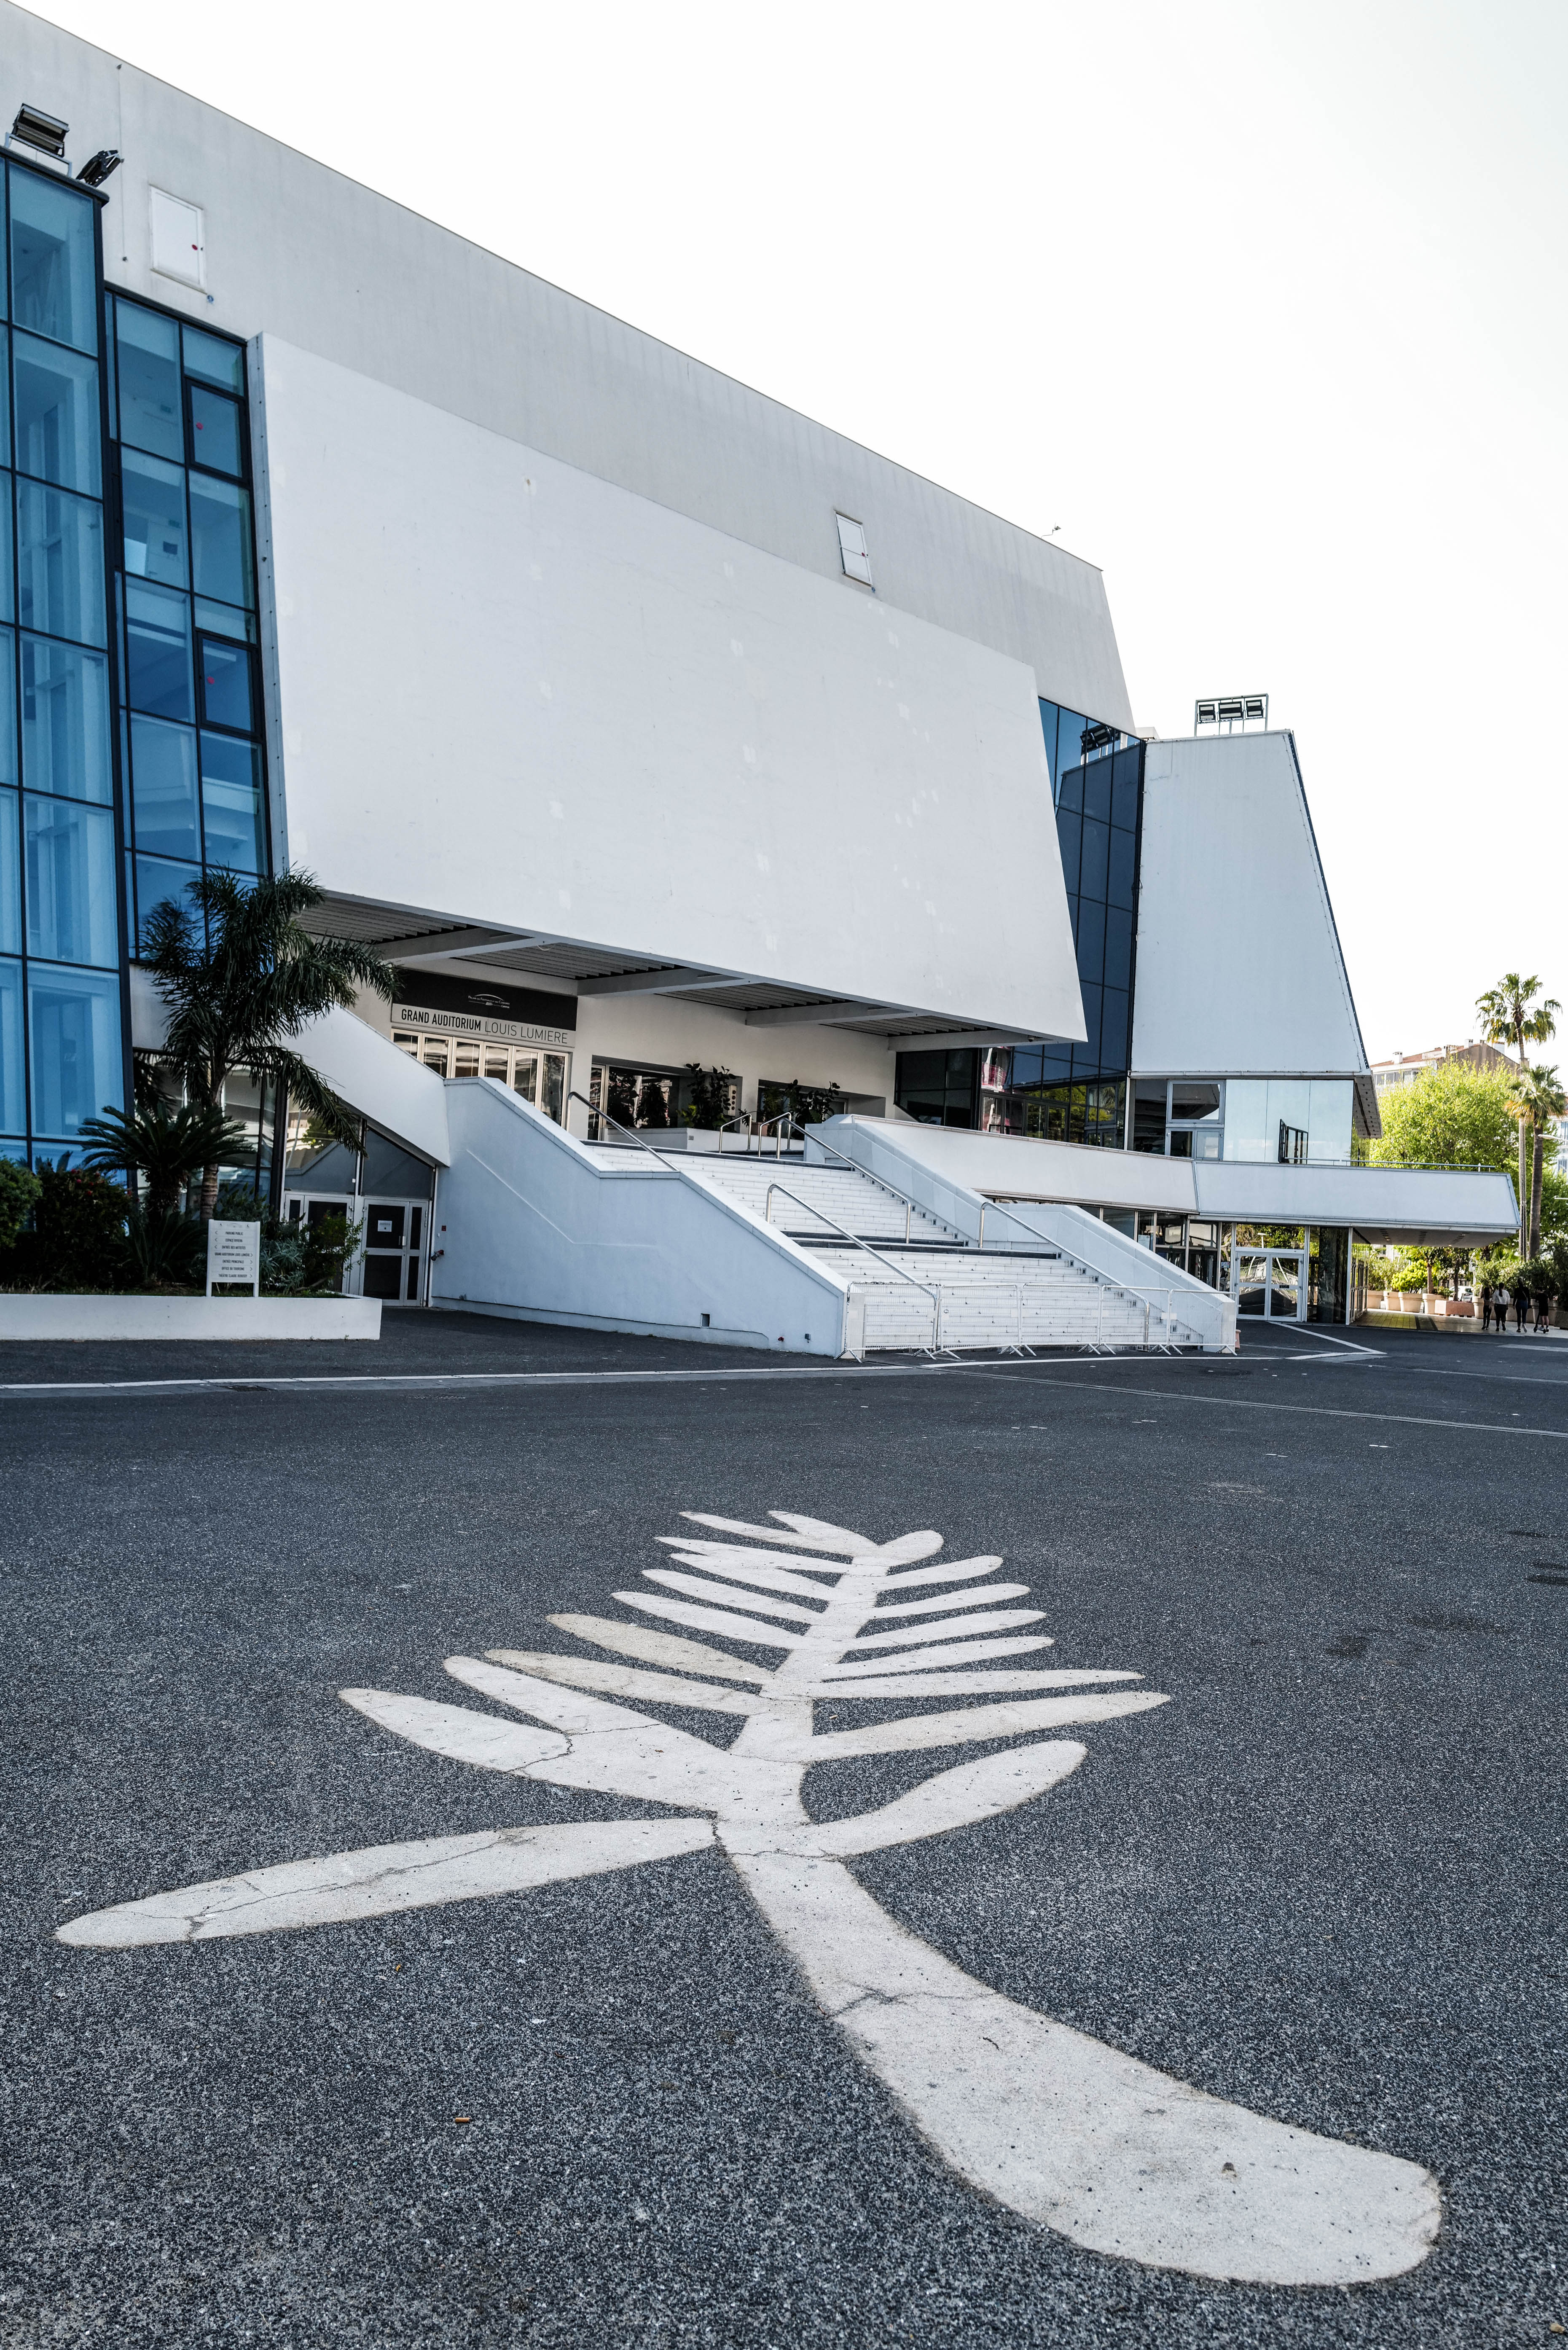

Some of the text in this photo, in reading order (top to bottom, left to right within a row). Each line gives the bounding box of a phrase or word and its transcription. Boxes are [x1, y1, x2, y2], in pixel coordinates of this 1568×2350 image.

[402, 1009, 568, 1044] GRAND AUDITORIUM LOUIS LUMIERE
